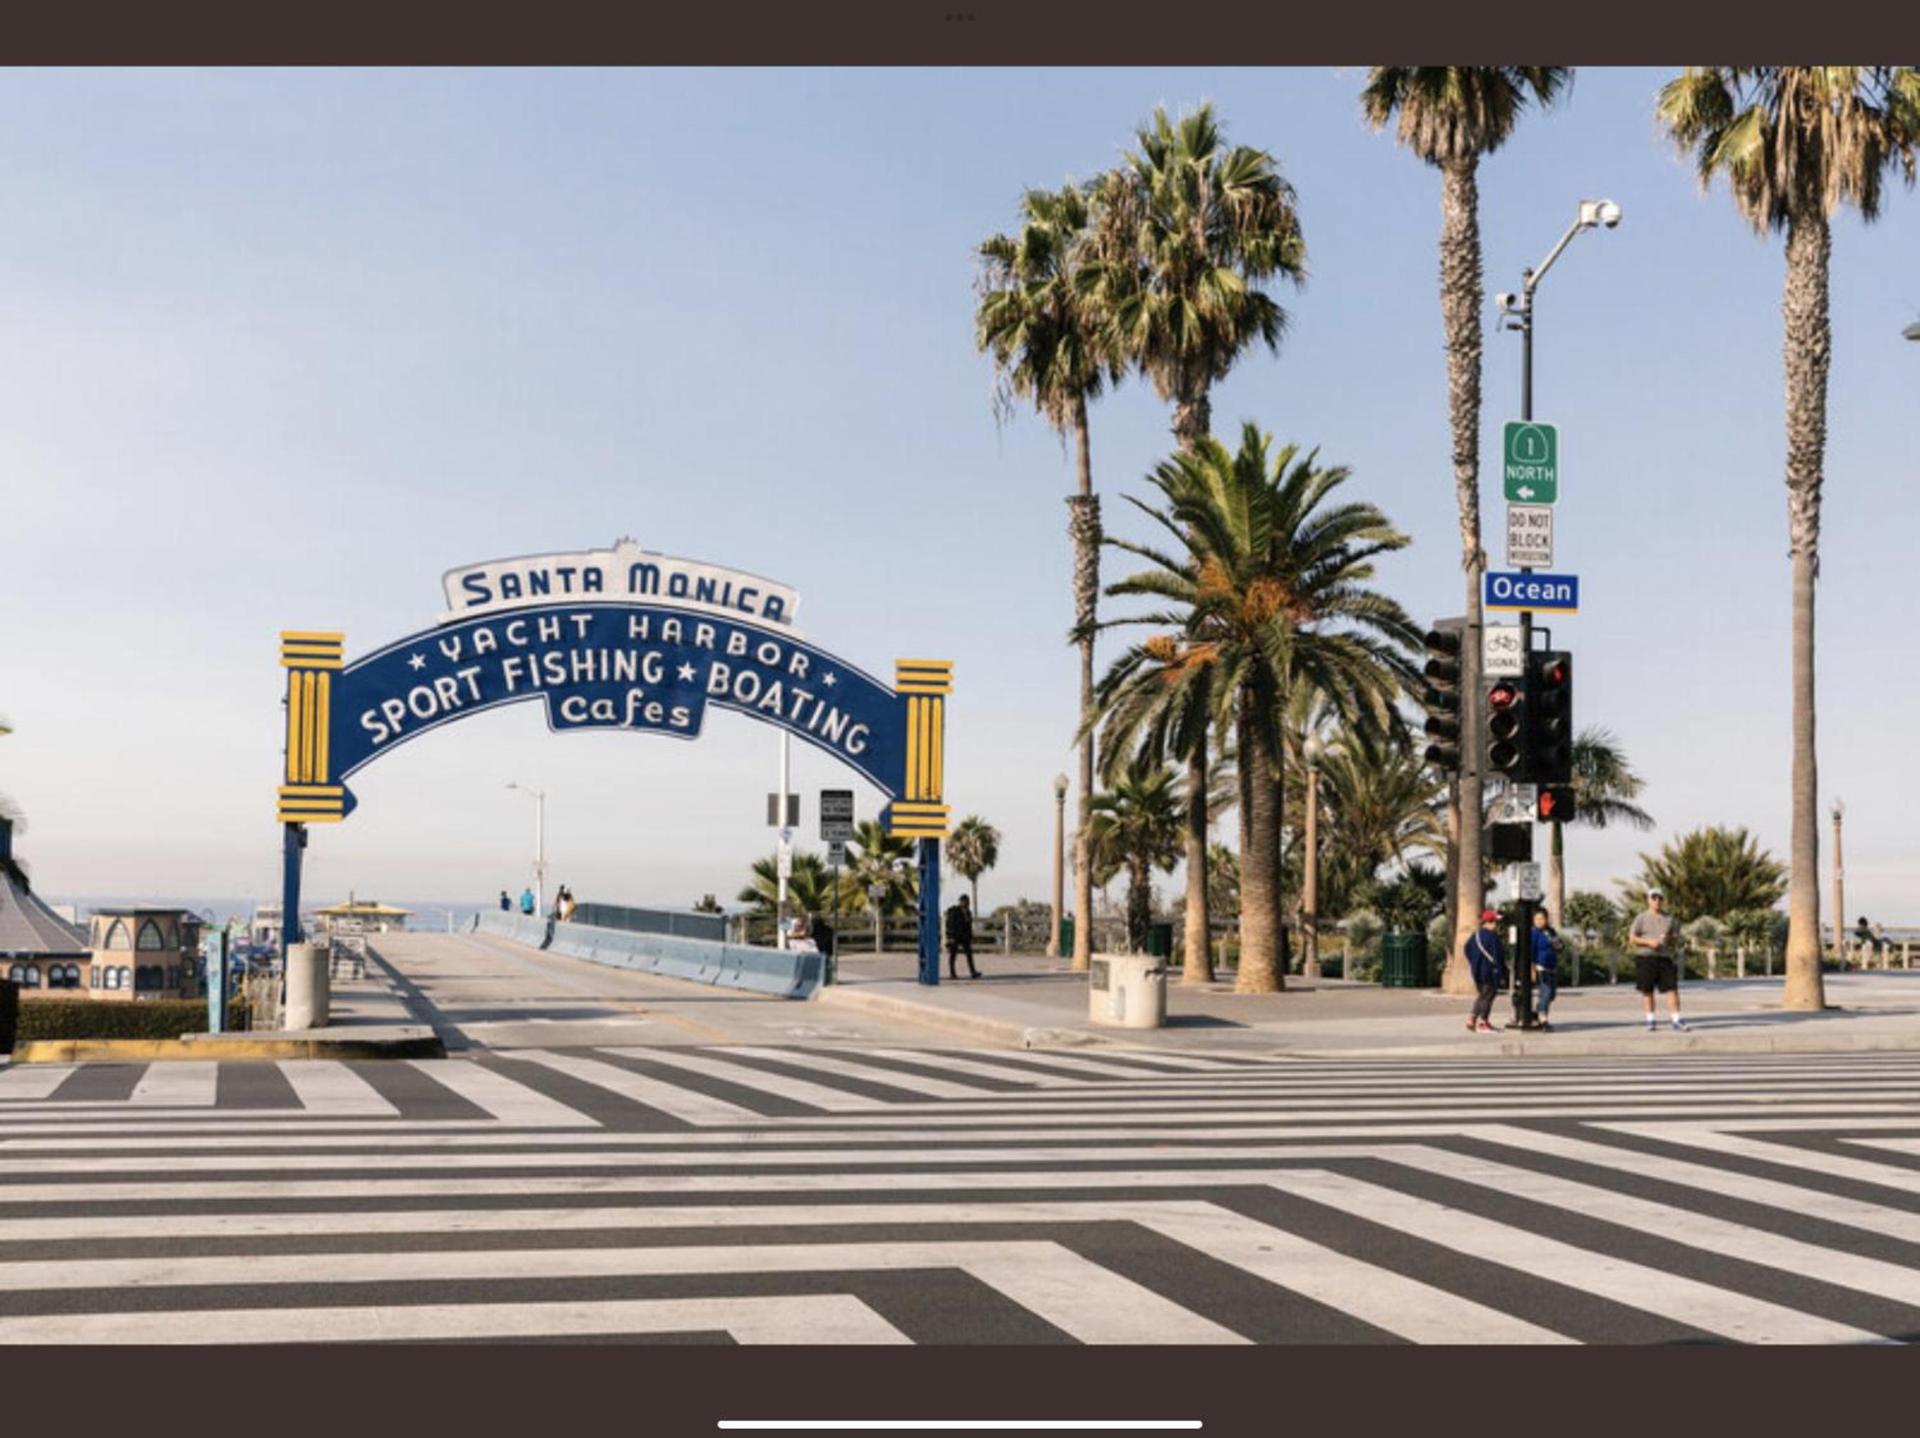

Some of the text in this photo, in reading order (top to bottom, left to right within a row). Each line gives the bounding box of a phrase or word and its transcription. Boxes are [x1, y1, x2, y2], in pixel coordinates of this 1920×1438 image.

[1527, 437, 1534, 456] 1
[1506, 465, 1554, 482] NORTH
[1510, 512, 1549, 529] DO NOT
[1510, 532, 1549, 549] BLOCK
[461, 562, 786, 621] SANTA MONICA
[1493, 577, 1571, 600] Ocean
[439, 614, 810, 679] YACHT HARBOR
[360, 649, 870, 755] SPORT FISHING BOATING
